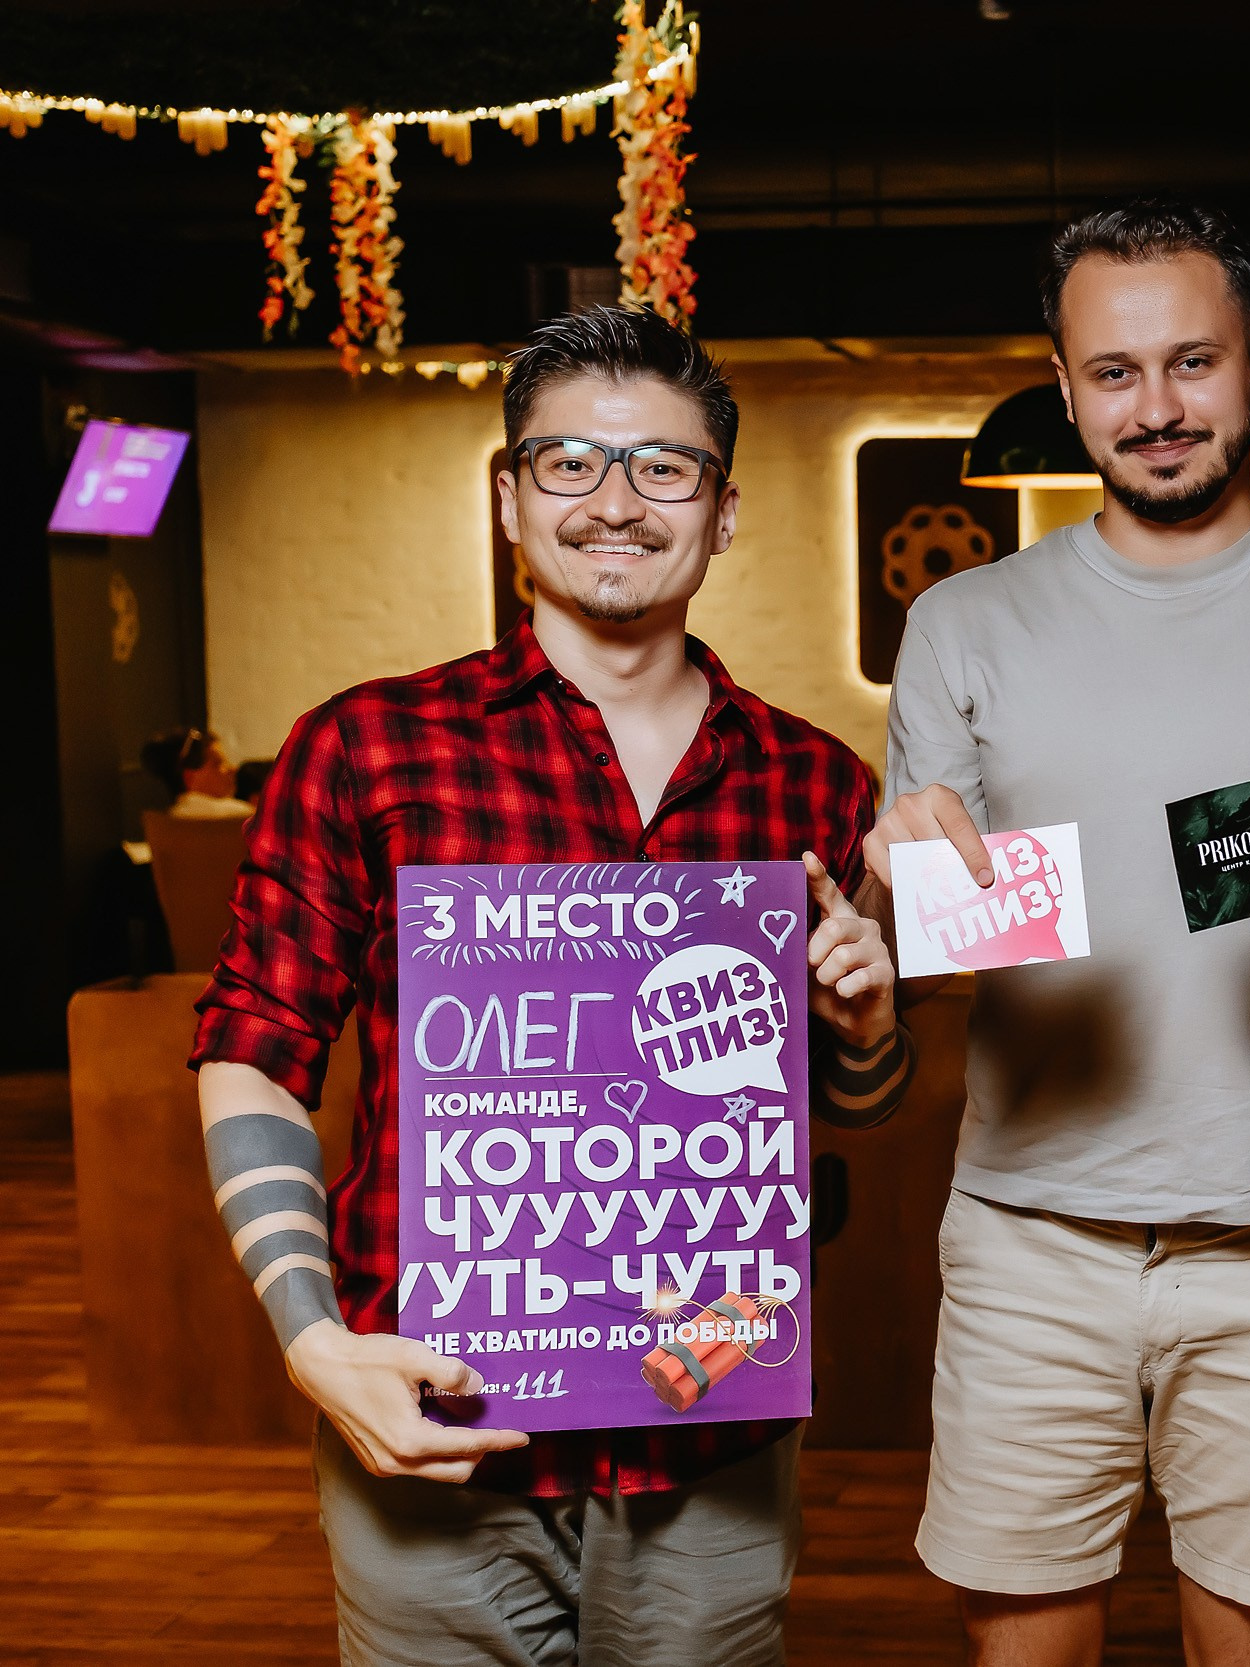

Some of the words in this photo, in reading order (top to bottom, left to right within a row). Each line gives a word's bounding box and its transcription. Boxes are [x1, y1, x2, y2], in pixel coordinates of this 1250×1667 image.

[1221, 861, 1244, 872] ЦЕНТР
[423, 895, 456, 940] 3
[475, 891, 680, 939] МЕСТО
[925, 872, 1064, 956] ПЛИЗ!
[635, 962, 782, 1032] КВИЗ,
[414, 991, 614, 1075] ОЛЕГ
[641, 1003, 788, 1075] ПЛИЗ!
[424, 1090, 587, 1117] КОМАНДЕ,
[425, 1105, 795, 1187] КОТОРОЙ
[424, 1333, 460, 1355] НЕ
[466, 1327, 601, 1354] ХВАТИЛО
[606, 1324, 651, 1351] ДО
[657, 1319, 777, 1346] ПОБЕДЫ
[512, 1369, 569, 1400] 111
